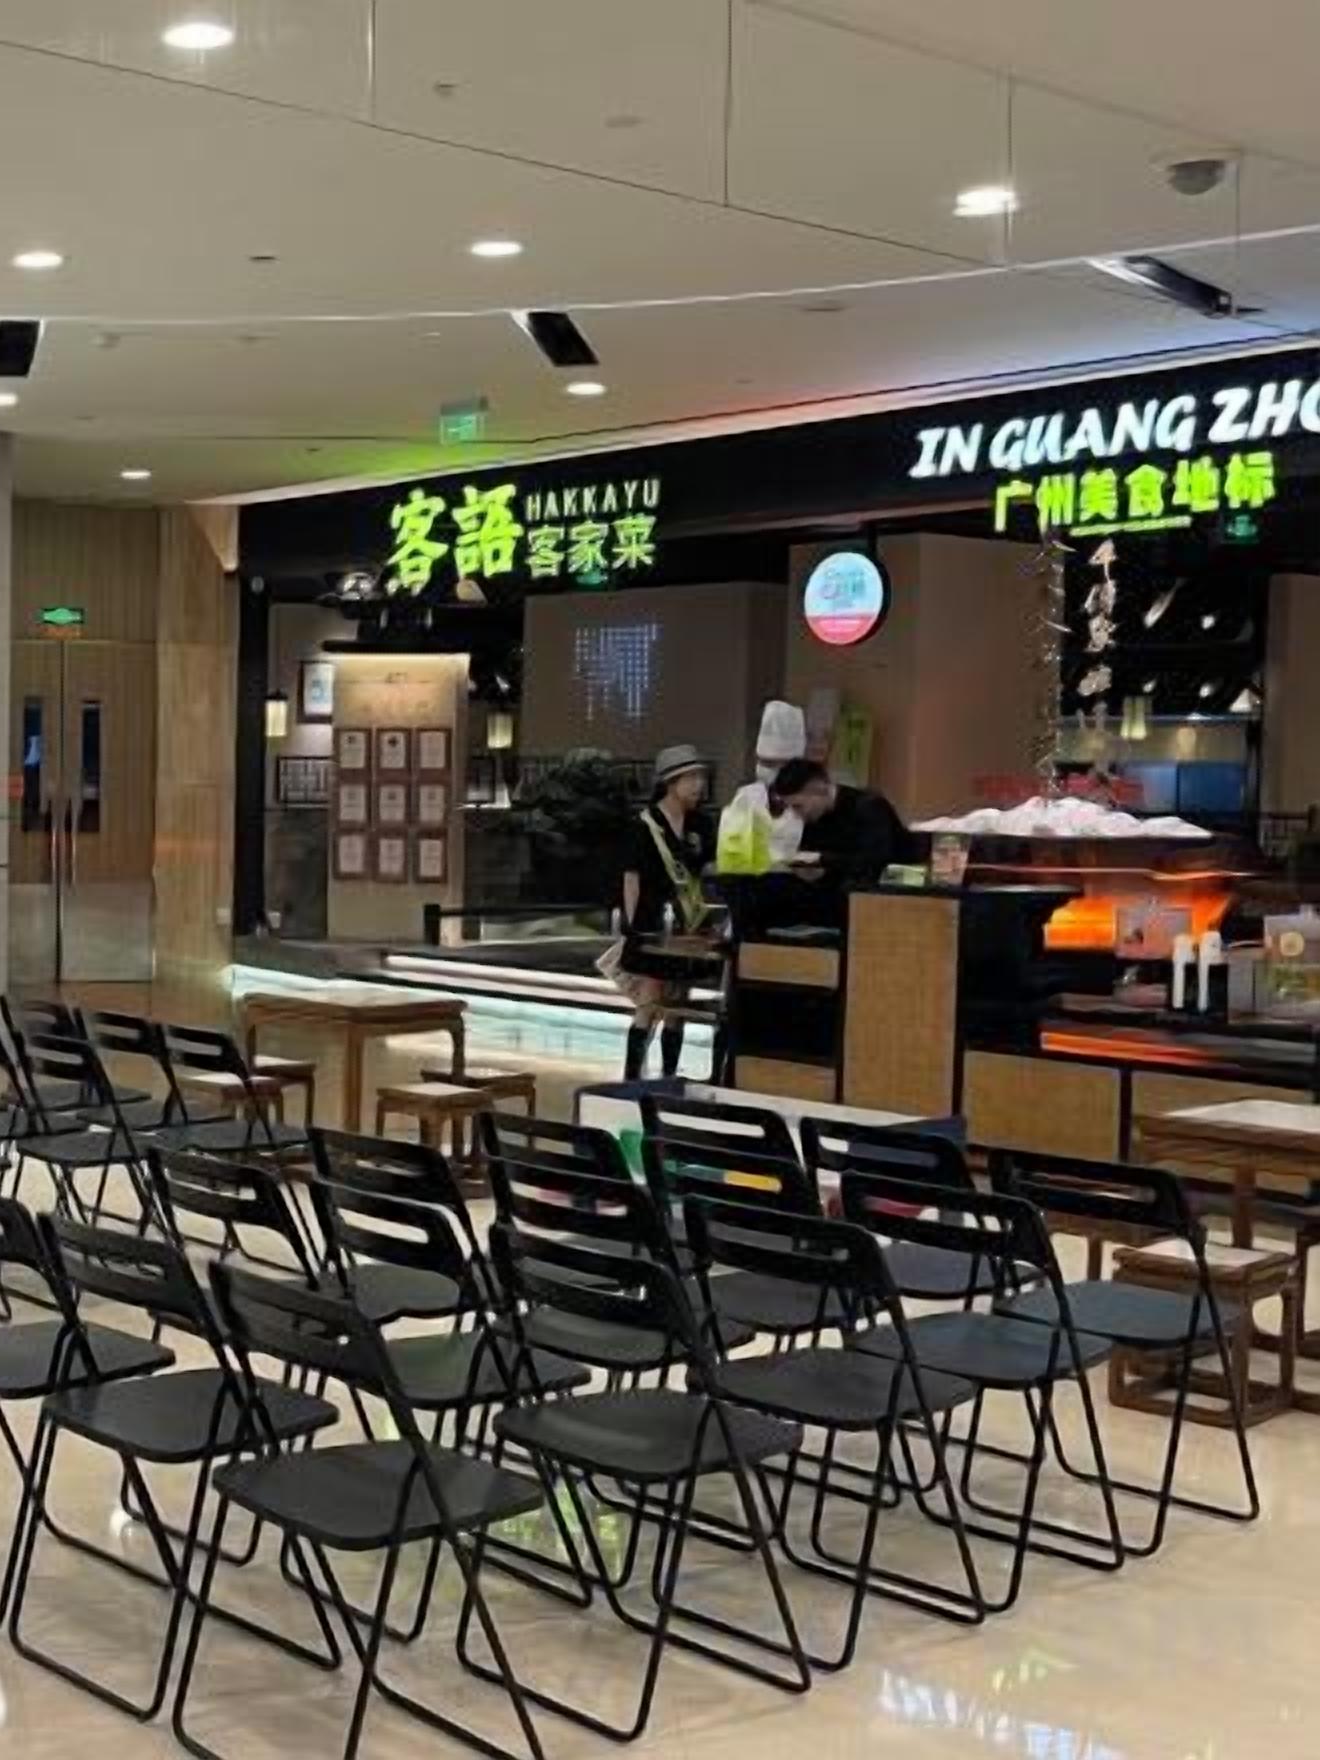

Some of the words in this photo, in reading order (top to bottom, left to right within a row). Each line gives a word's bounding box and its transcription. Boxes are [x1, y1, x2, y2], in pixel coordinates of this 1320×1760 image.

[909, 423, 983, 478] IN
[988, 394, 1197, 471] GUANG
[525, 479, 661, 521] HAKKAYU
[993, 452, 1276, 534] 广州美食地标
[525, 513, 658, 578] 客家菜
